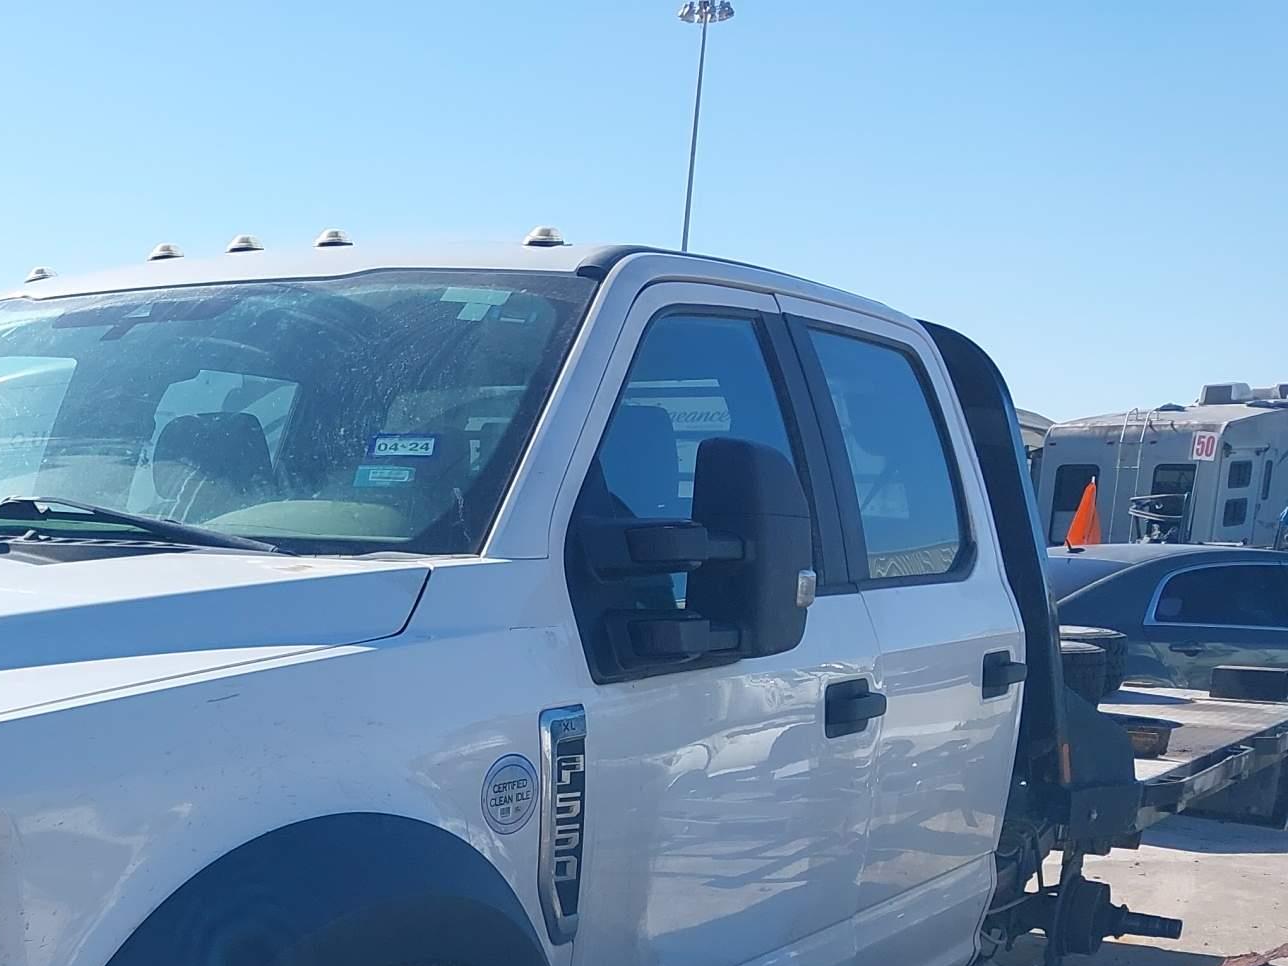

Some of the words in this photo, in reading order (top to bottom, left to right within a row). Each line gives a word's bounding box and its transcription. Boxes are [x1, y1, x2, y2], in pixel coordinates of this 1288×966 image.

[1195, 434, 1216, 458] 50
[562, 720, 577, 732] XL
[492, 778, 529, 794] CERTIFIED
[489, 795, 514, 808] CLEAN
[515, 790, 532, 802] IDLE
